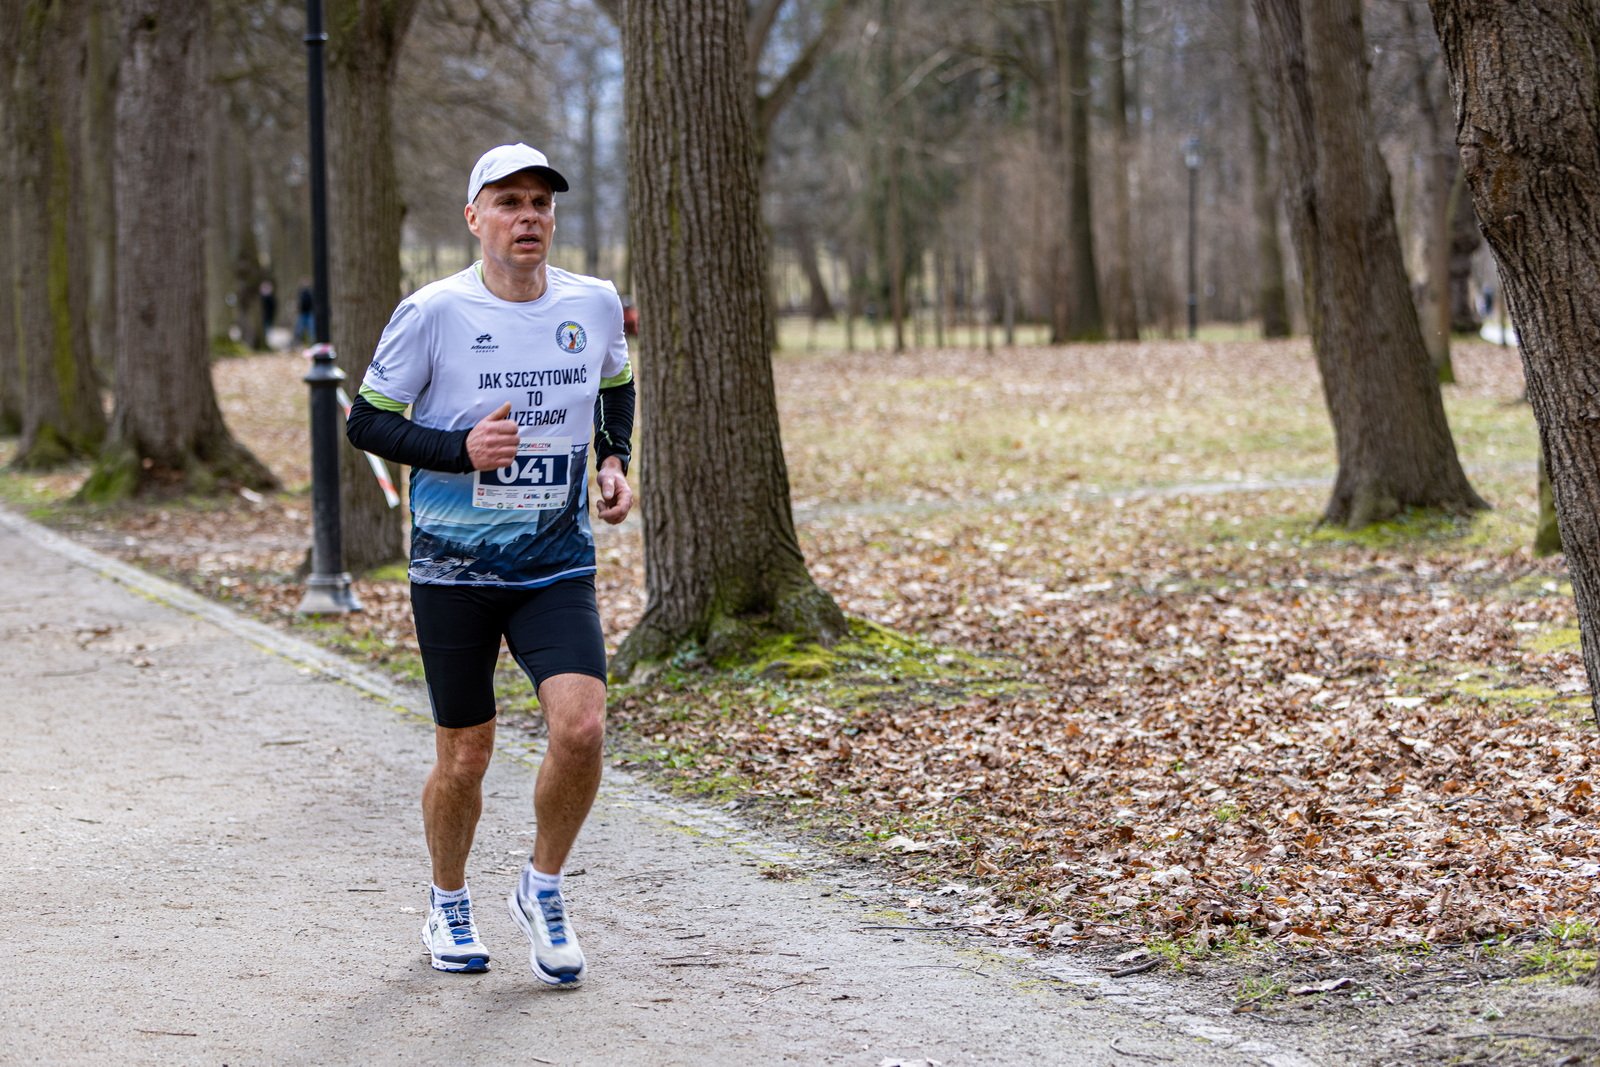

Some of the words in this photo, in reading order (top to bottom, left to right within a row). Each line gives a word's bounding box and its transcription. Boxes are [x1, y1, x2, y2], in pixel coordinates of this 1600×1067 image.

[478, 373, 502, 389] JAK
[505, 364, 587, 388] SZCZYTOWAĆ
[527, 391, 543, 407] TO
[514, 408, 567, 427] IZERACH
[497, 457, 555, 484] 041
